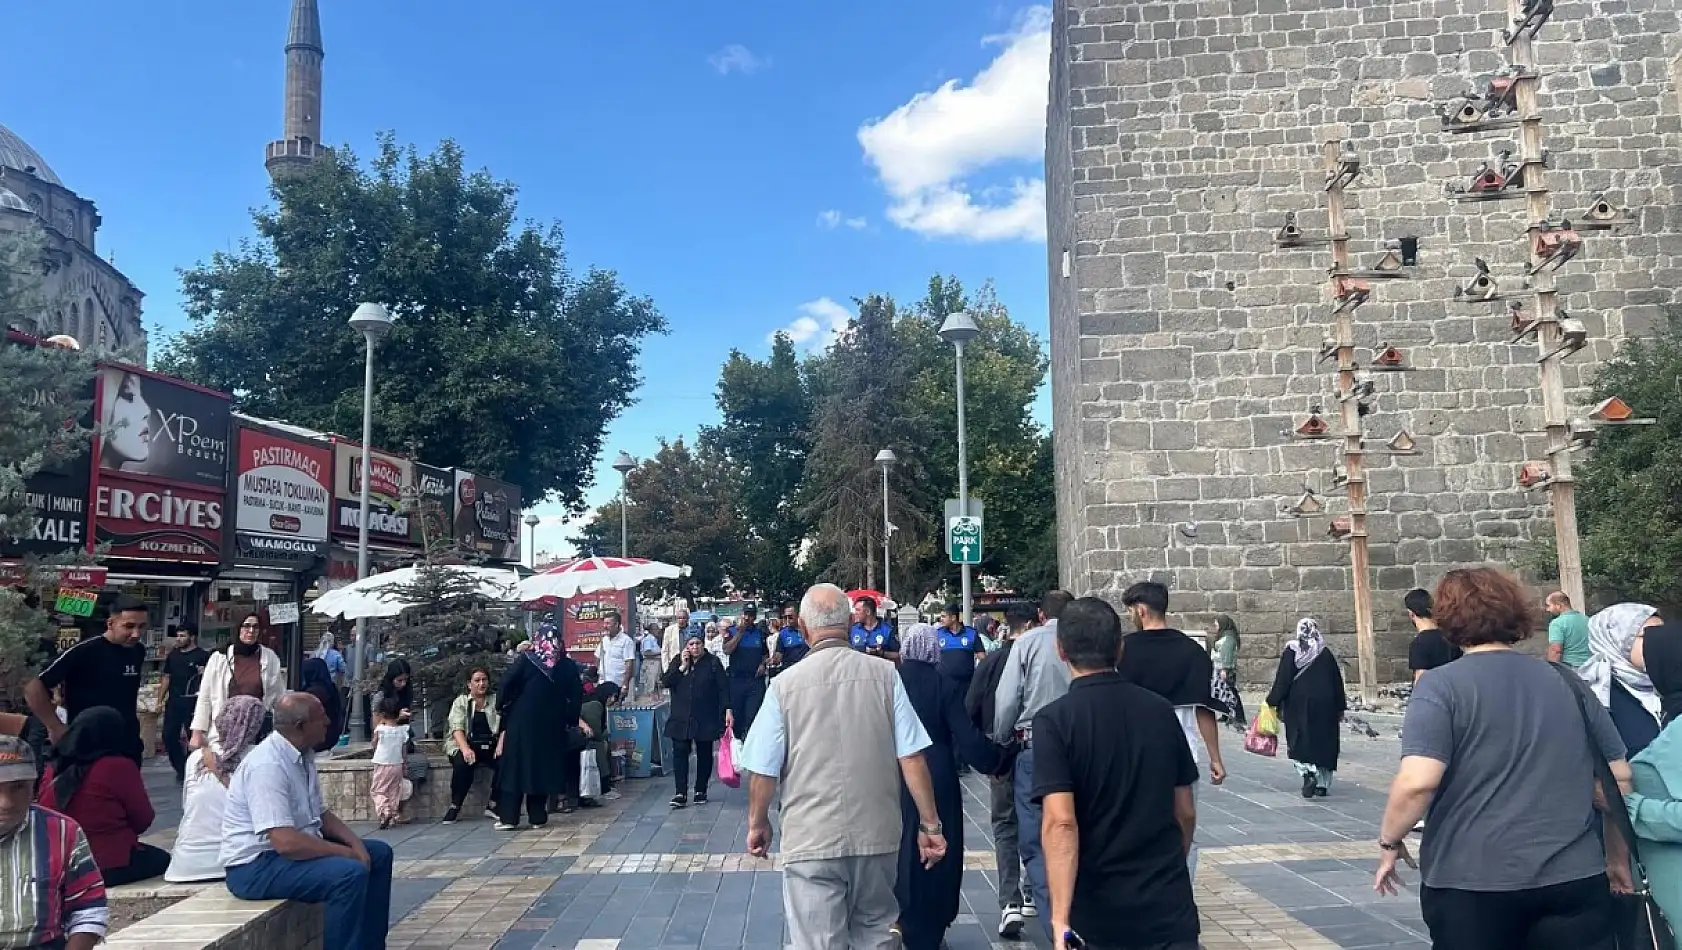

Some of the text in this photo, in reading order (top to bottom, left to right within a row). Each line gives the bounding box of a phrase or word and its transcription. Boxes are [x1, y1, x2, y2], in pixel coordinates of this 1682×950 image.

[178, 444, 224, 465] Beauty
[252, 446, 321, 479] PASTIRMACI
[243, 474, 325, 503] MUSTAFA TOKLUMAN
[96, 486, 222, 530] ERCİYES
[952, 535, 978, 545] PARK
